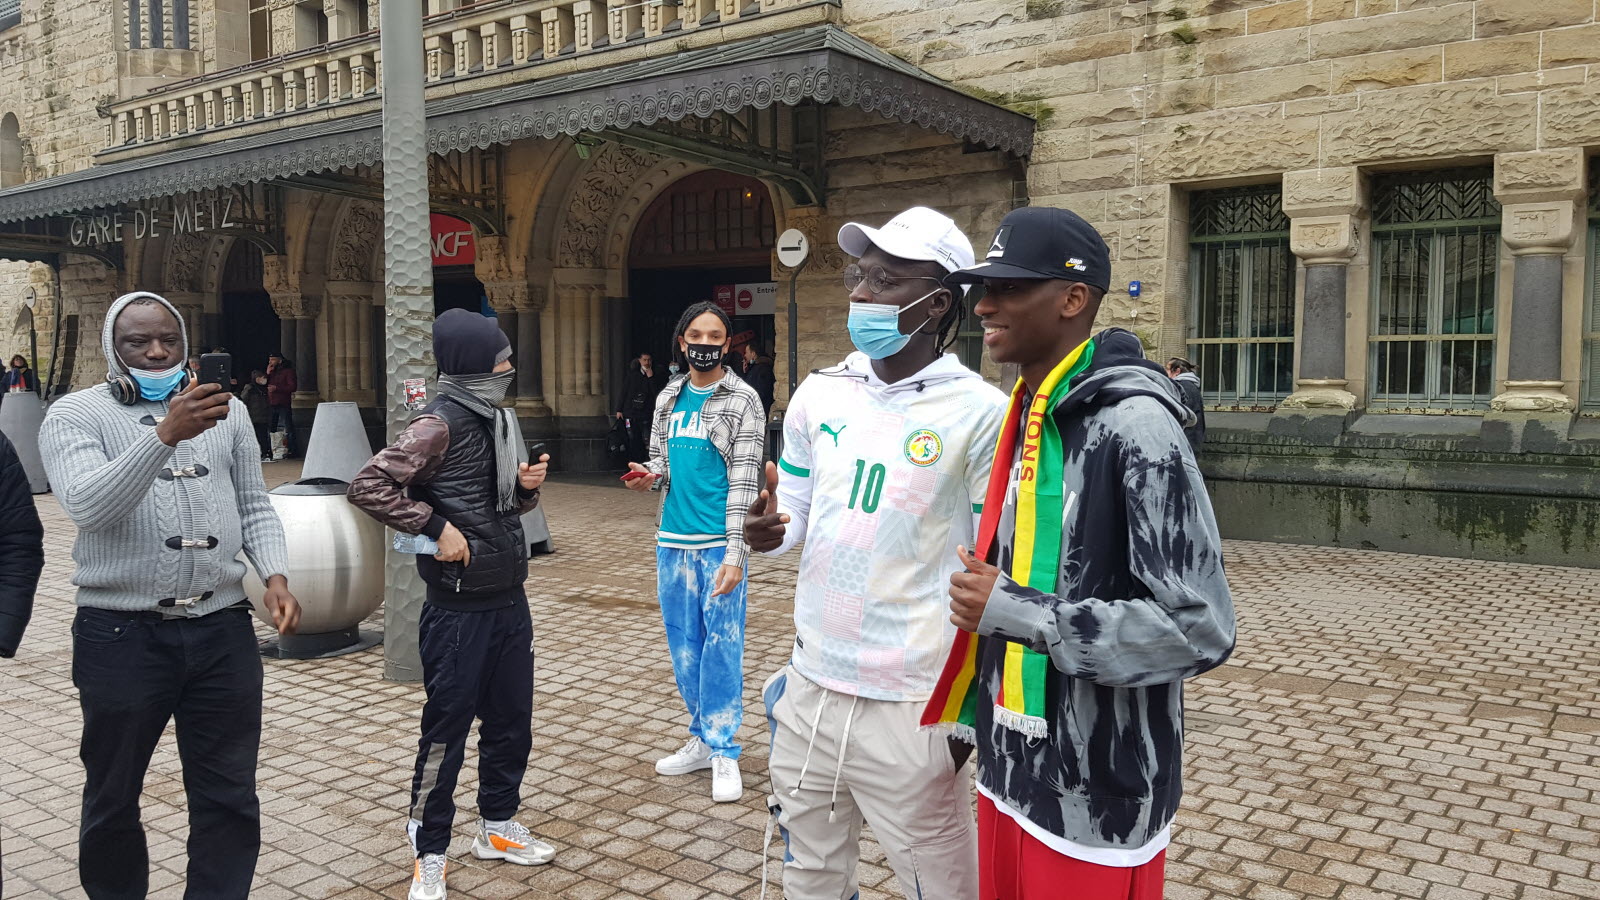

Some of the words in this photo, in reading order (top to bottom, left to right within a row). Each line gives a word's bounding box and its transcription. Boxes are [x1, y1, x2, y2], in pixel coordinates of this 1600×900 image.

[70, 212, 122, 246] GARE
[134, 207, 160, 240] DE
[172, 195, 234, 236] METZ
[1020, 393, 1049, 482] LIONS
[847, 458, 886, 514] 10
